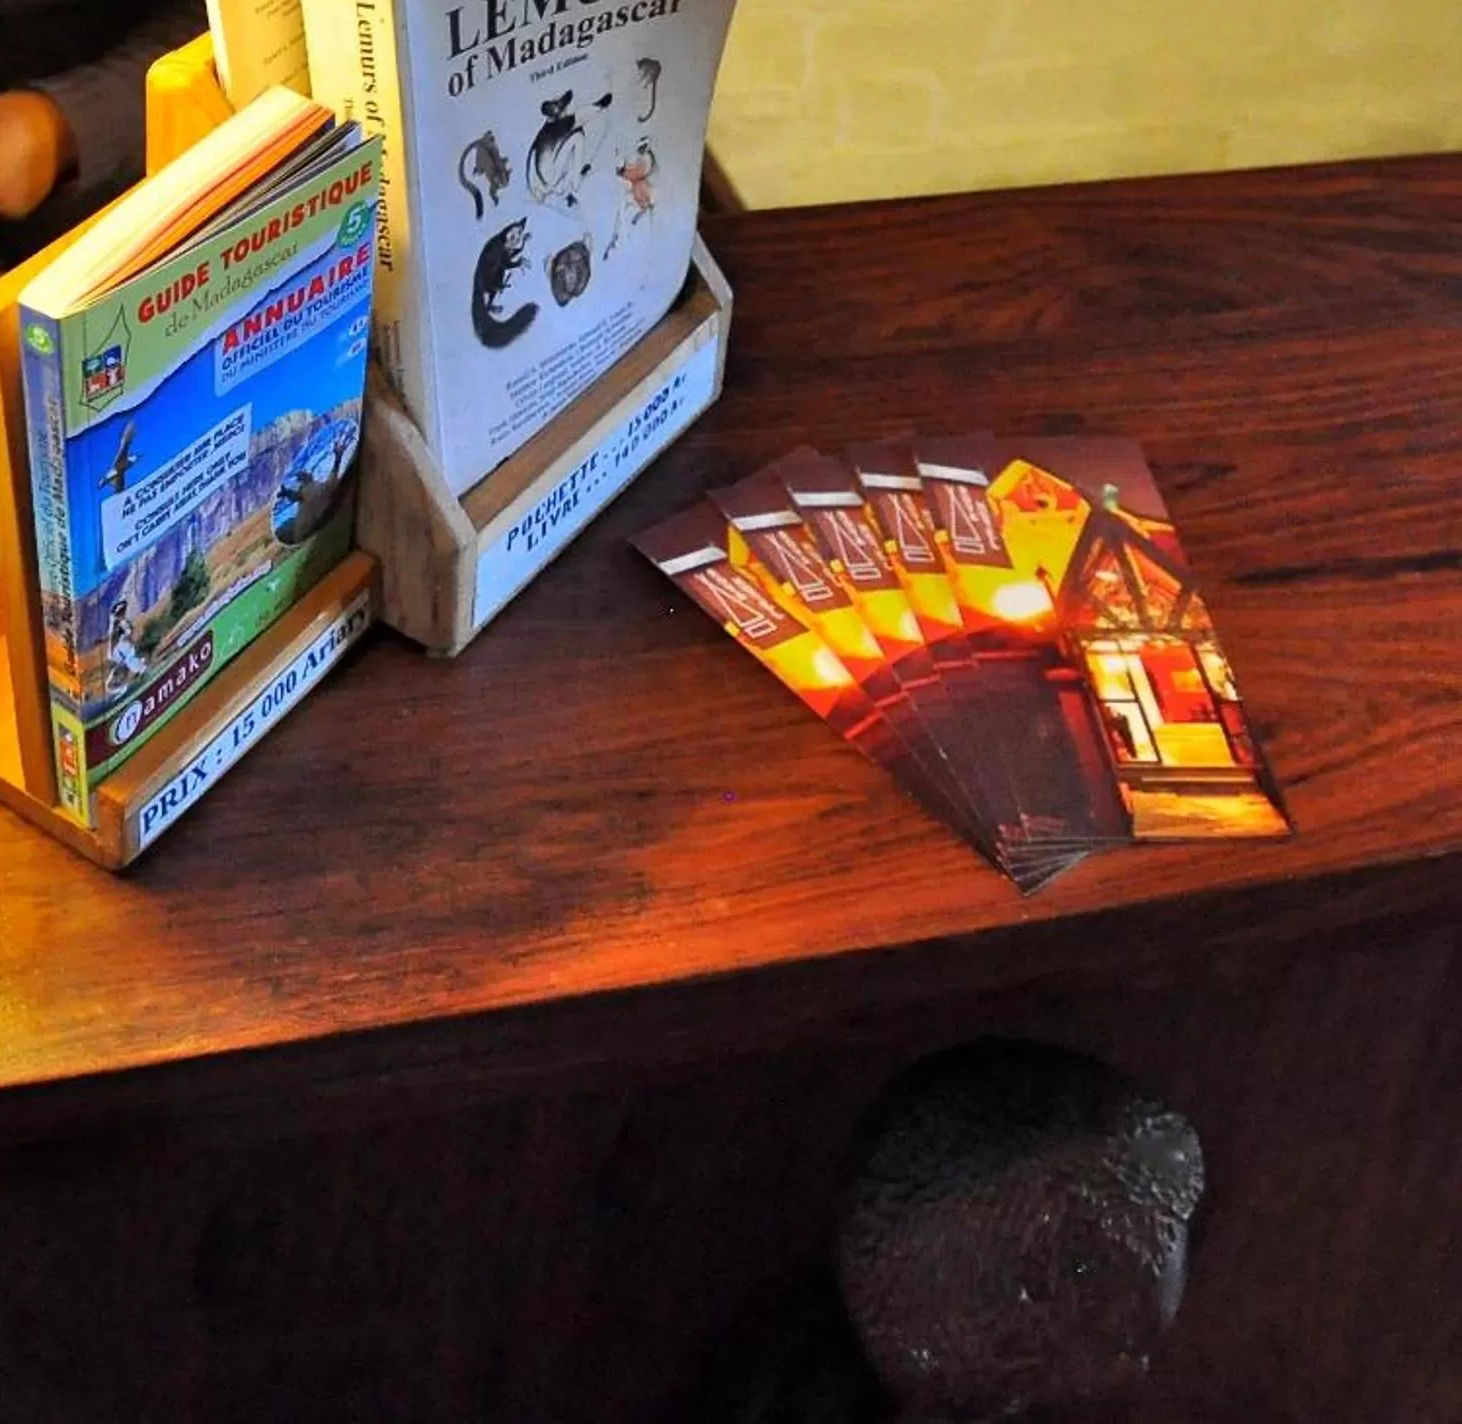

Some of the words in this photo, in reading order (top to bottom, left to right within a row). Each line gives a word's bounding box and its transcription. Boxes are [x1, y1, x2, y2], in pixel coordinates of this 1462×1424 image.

[356, 1, 377, 93] Lemurs
[447, 54, 479, 98] of
[364, 99, 387, 128] of
[137, 260, 212, 326] GUIDE
[219, 160, 374, 272] TOURISTIQUE
[190, 239, 300, 316] Madagascar
[221, 327, 279, 371] OFFICIEL
[283, 311, 304, 332] DU
[306, 266, 369, 317] TOURISME
[222, 240, 372, 356] ANNUAIRE
[527, 488, 580, 552] LIVRE
[142, 758, 208, 835] PRIX
[231, 713, 256, 759] 15
[261, 670, 298, 719] 000
[301, 603, 367, 680] Ariary
